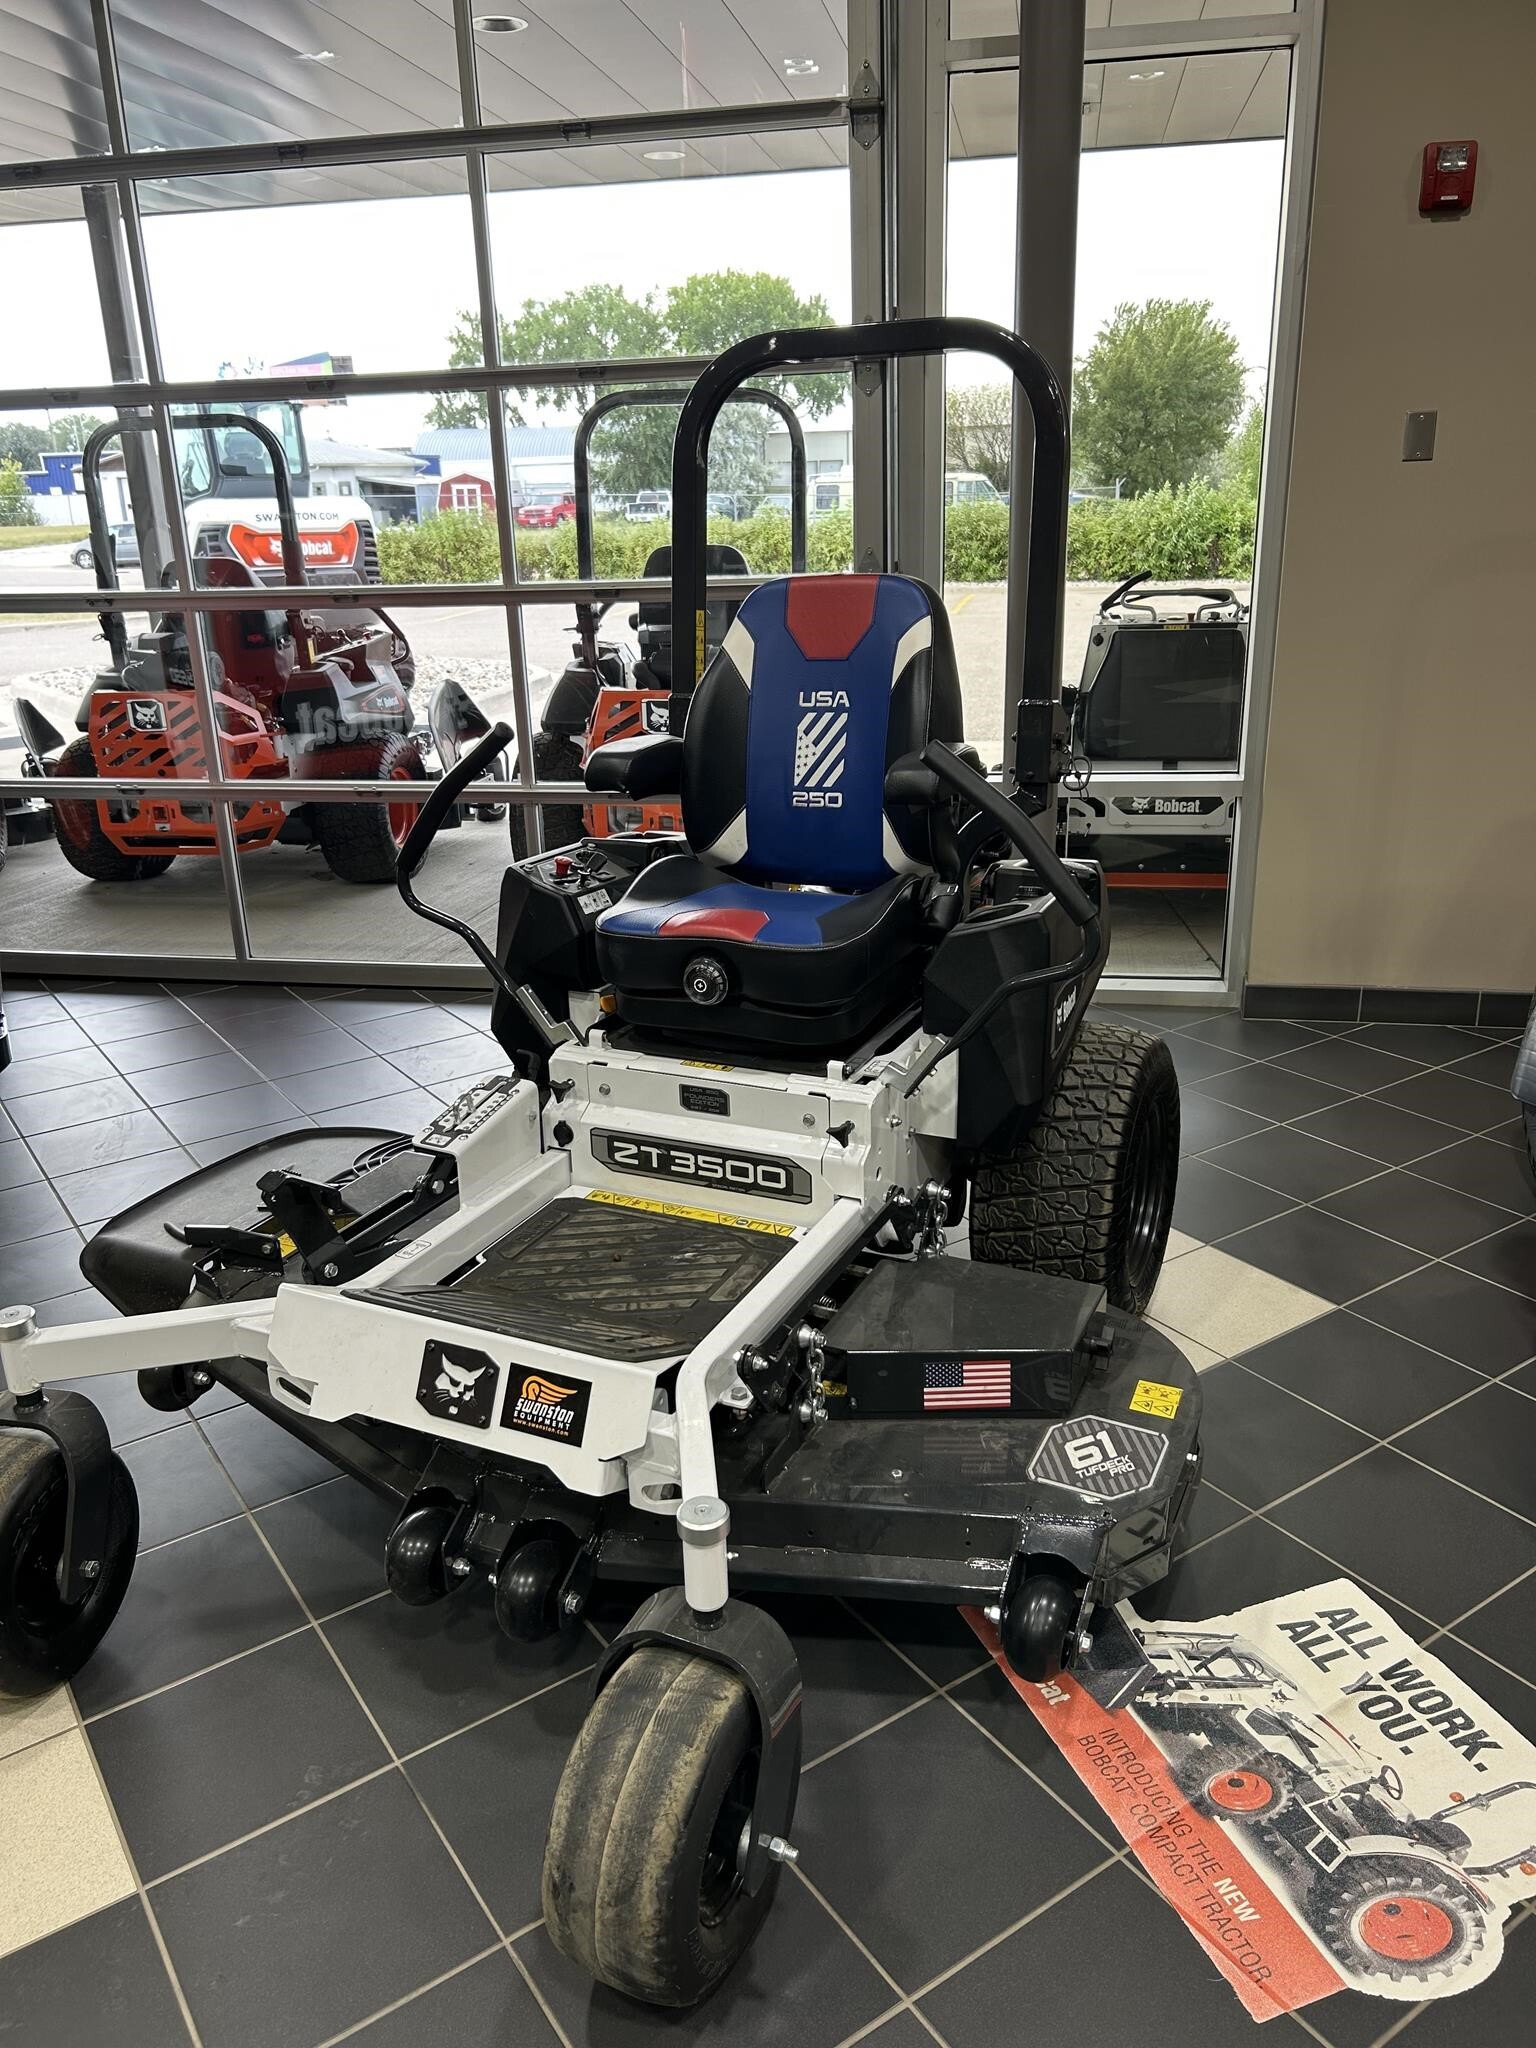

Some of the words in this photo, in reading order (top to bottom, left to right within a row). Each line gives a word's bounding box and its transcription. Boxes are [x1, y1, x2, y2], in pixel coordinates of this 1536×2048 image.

[799, 690, 850, 707] USA
[792, 791, 843, 808] 250
[1154, 799, 1200, 813] Bobcat
[613, 1141, 787, 1190] ZT3500
[513, 1410, 570, 1430] EQUIPMENT
[513, 1418, 569, 1437] www.swanston.com
[1064, 1430, 1118, 1470] 61
[1075, 1455, 1131, 1479] TUFDECK
[1109, 1462, 1136, 1477] PRO
[1276, 1619, 1350, 1674] ALL
[1340, 1671, 1429, 1756] YOU.
[1315, 1607, 1389, 1660] ALL
[1378, 1658, 1504, 1773] WORK.
[1099, 1728, 1193, 1838] INTRODUCING
[1188, 1838, 1224, 1877] THE
[1212, 1877, 1261, 1922] NEW
[1129, 1803, 1204, 1886] COMPACT
[1195, 1889, 1272, 1988] TRACTOR
